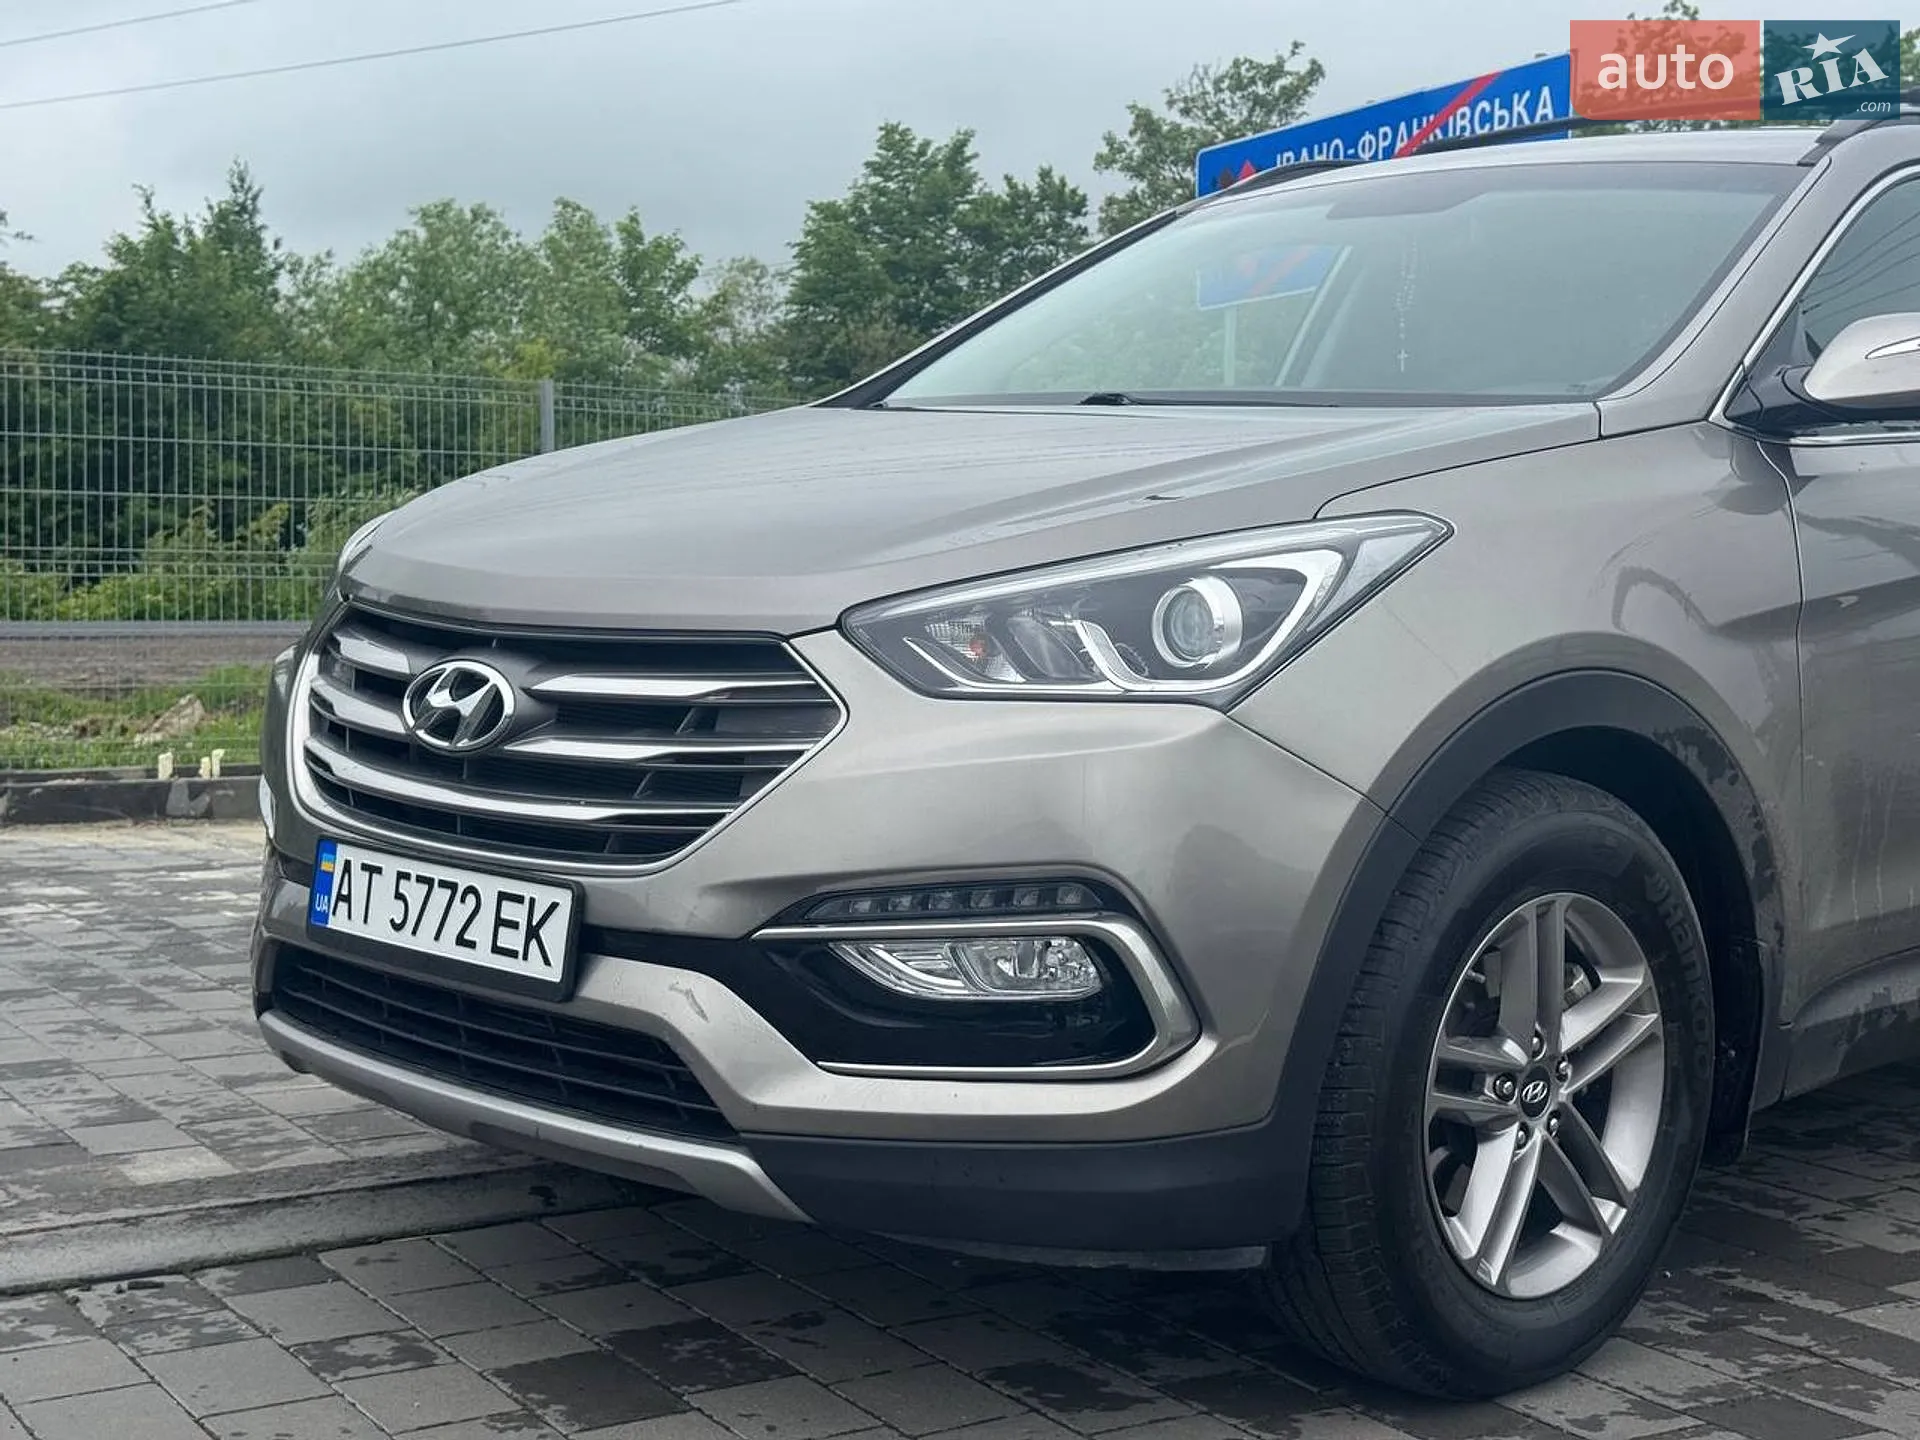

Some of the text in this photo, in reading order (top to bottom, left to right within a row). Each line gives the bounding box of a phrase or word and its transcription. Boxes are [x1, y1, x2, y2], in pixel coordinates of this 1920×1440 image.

[314, 892, 329, 914] UA
[331, 858, 561, 968] AT 5772 EK
[1655, 895, 1711, 1096] Hankoo
